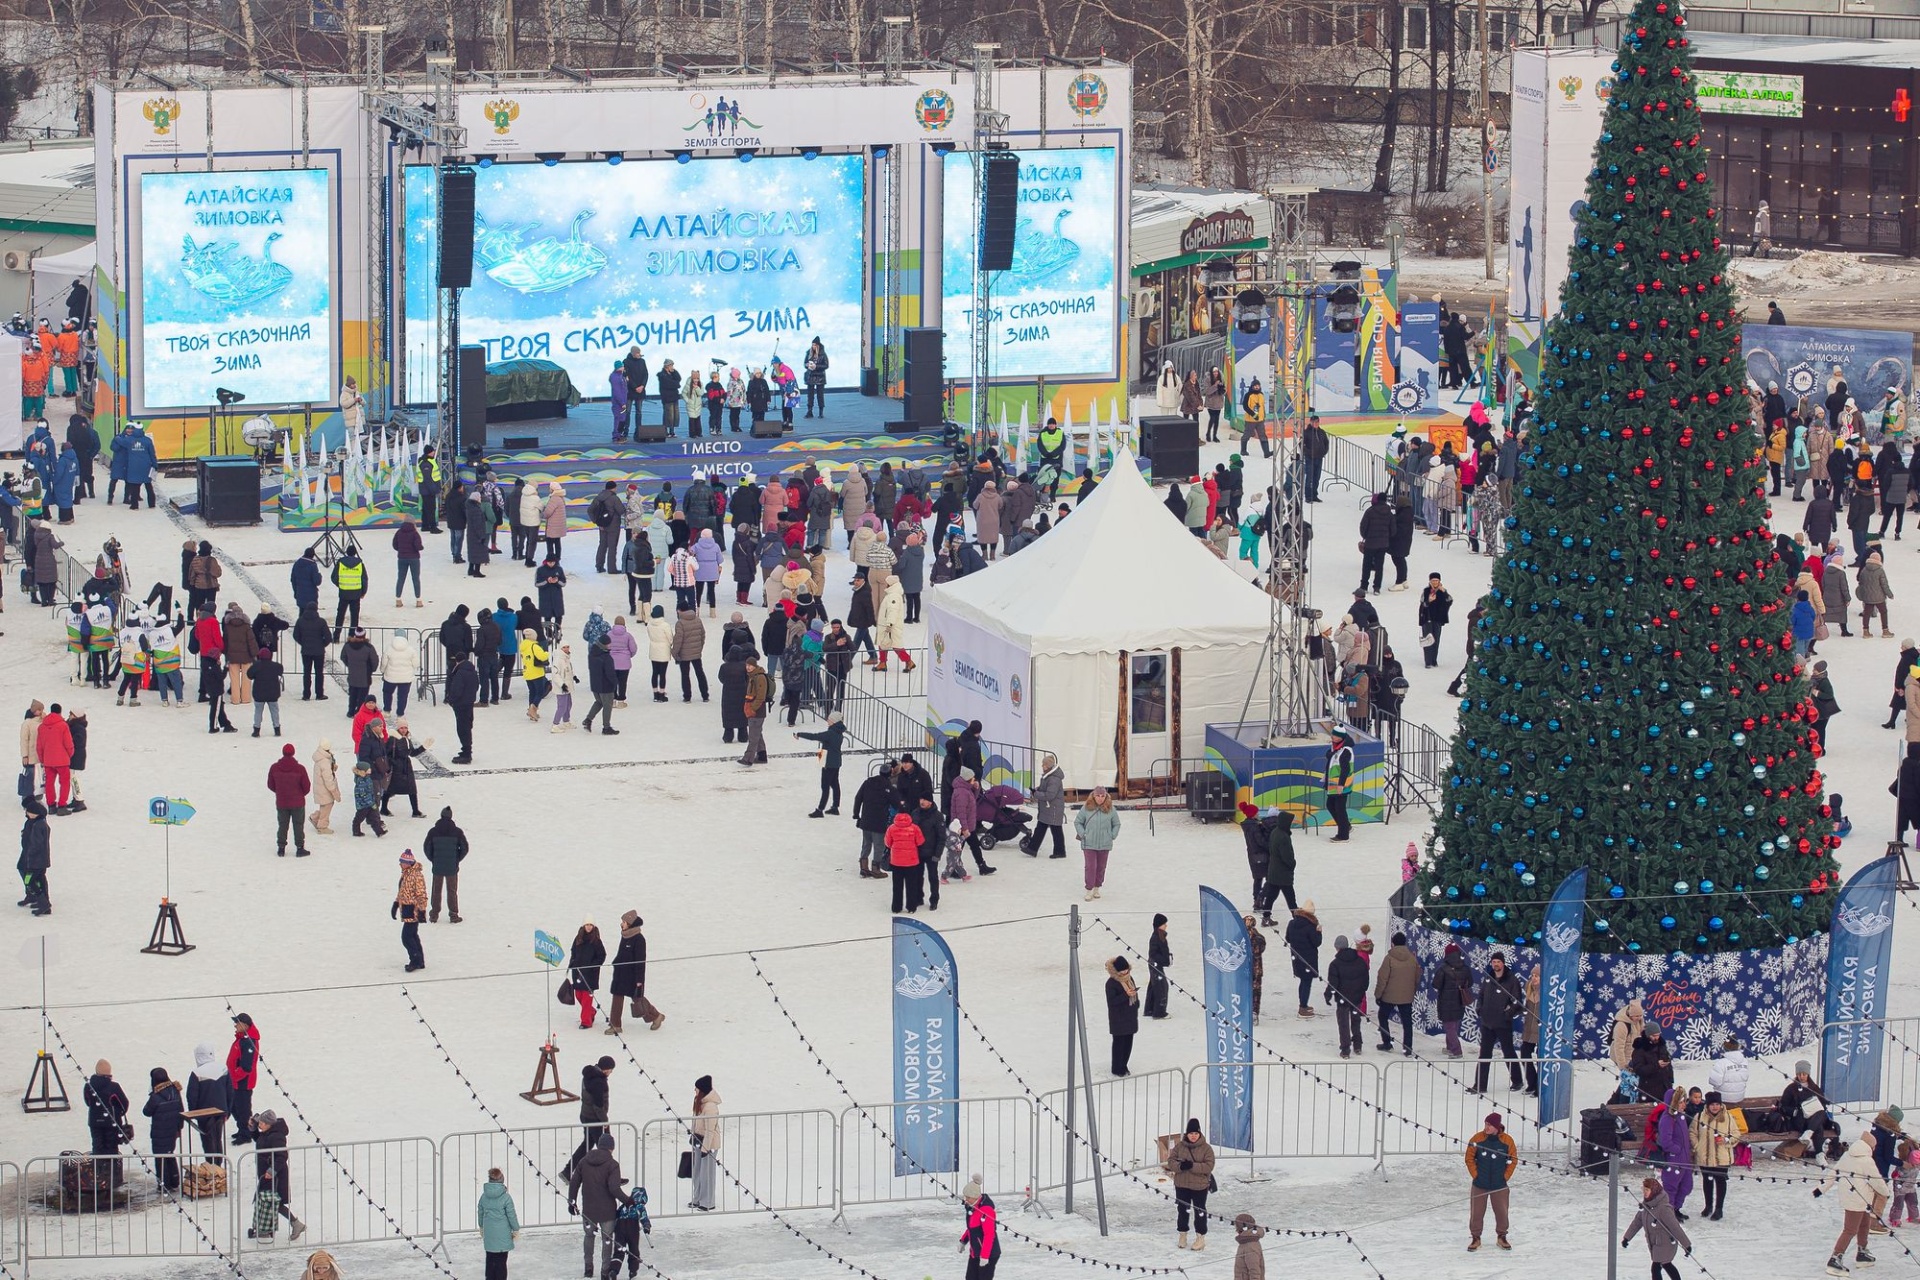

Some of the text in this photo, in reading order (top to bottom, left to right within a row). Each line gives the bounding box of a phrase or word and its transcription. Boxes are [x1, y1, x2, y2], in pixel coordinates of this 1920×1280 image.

[1698, 86, 1794, 102] АПТЕКА АЛТАЯ
[684, 137, 761, 147] ЗЕМЛЯ СПОРТА
[184, 185, 293, 205] АЛТАЙСКАЯ
[194, 209, 284, 226] ЗИМОВКА
[629, 206, 819, 240] АЛТАЙСКАЯ
[1184, 218, 1254, 251] СЫРНАЯ ЛАВКА
[645, 246, 802, 275] ЗИМОВКА
[1010, 295, 1095, 319] СКАЗОЧНАЯ
[166, 322, 311, 353] ТВОЯ СКАЗОЧНАЯ
[480, 305, 811, 362] ТВОЯ СКАЗОЧНАЯ ЗИМА
[1003, 325, 1050, 345] ЗИМА
[1801, 341, 1856, 353] АЛТАЙСКАЯ
[211, 353, 262, 374] ЗИМА
[1806, 353, 1850, 363] ЗИМОВКА
[1372, 346, 1384, 393] ЗЕМЛЯ
[682, 440, 742, 455] 1 МЕСТО
[691, 461, 753, 476] 2 МЕСТО
[955, 659, 975, 682] ЗЕМЛЯ
[975, 670, 1000, 695] СПОРТА
[535, 937, 560, 957] КАТОК
